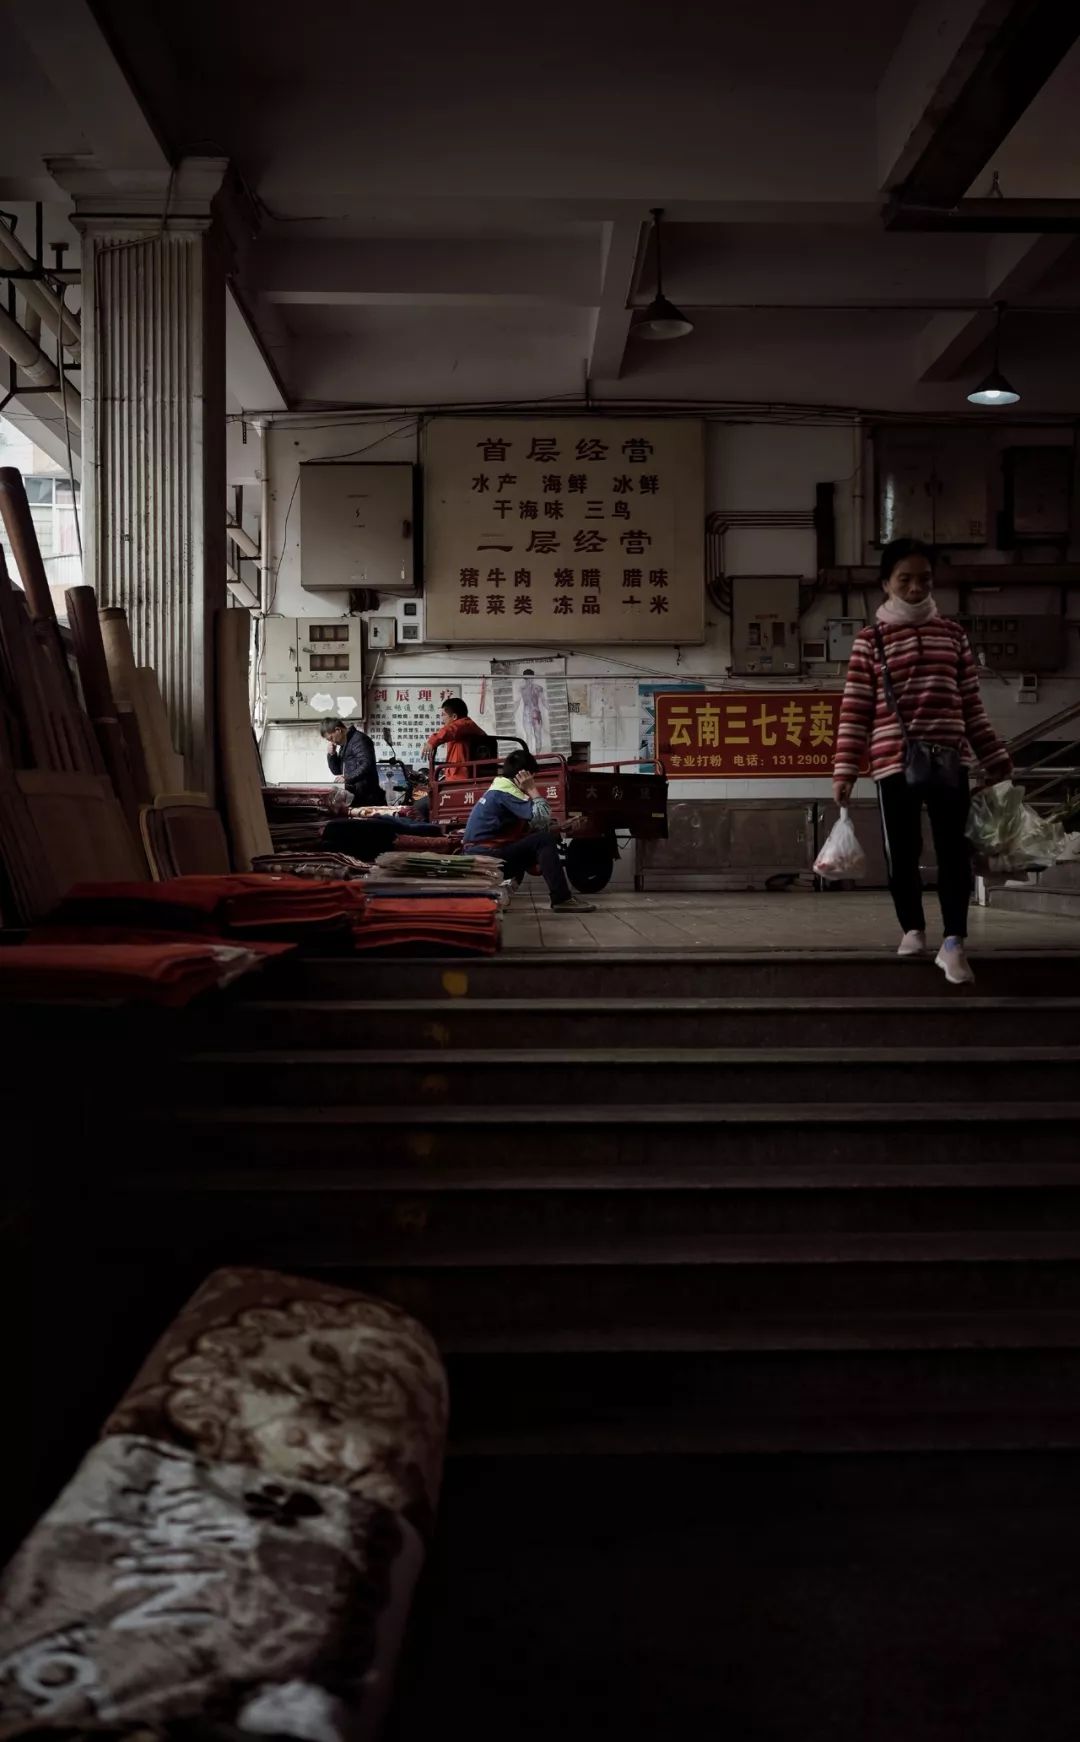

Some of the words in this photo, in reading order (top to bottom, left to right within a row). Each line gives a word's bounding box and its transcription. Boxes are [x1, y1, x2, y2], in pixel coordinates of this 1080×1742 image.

[476, 437, 654, 463] 首层经营
[472, 474, 517, 494] 水产
[543, 474, 588, 494] 海鲜
[612, 475, 660, 495] 冰鲜
[492, 499, 564, 520] 干海味
[585, 500, 631, 520] 三鸟
[459, 567, 532, 588] 猪牛肉
[553, 567, 602, 588] 烧腊
[622, 568, 669, 588] 腊味
[460, 595, 533, 615] 蔬菜类
[553, 595, 602, 615] 冻品
[667, 701, 835, 747] 云南三七专卖
[669, 754, 723, 768] 专业打粉
